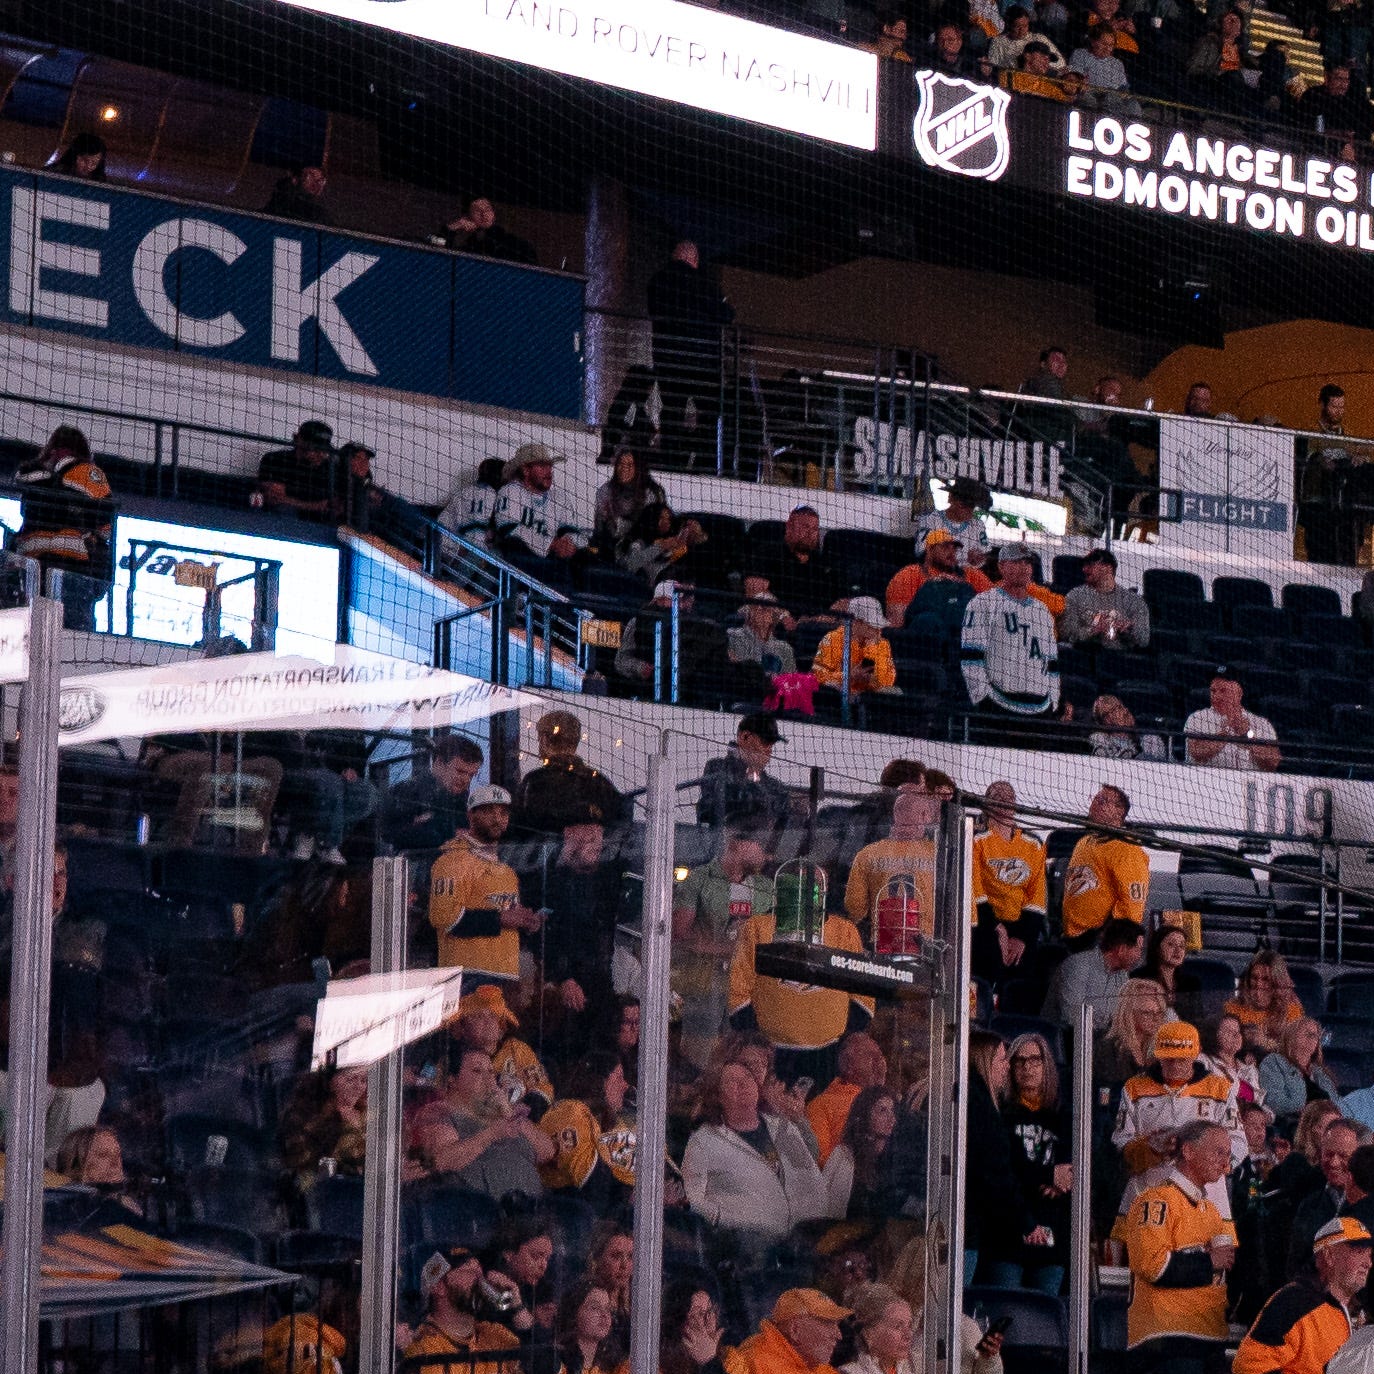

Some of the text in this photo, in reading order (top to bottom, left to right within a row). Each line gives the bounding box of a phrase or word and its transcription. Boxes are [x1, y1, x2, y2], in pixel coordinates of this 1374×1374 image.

[592, 17, 708, 69] ROVER
[933, 104, 994, 152] NHL
[1068, 111, 1152, 162] LOS
[1162, 133, 1359, 203] ANGELES
[1067, 155, 1304, 237] EDMONTON
[10, 187, 381, 377] ECK
[1182, 496, 1271, 526] FLIGHT
[1245, 779, 1333, 839] 109
